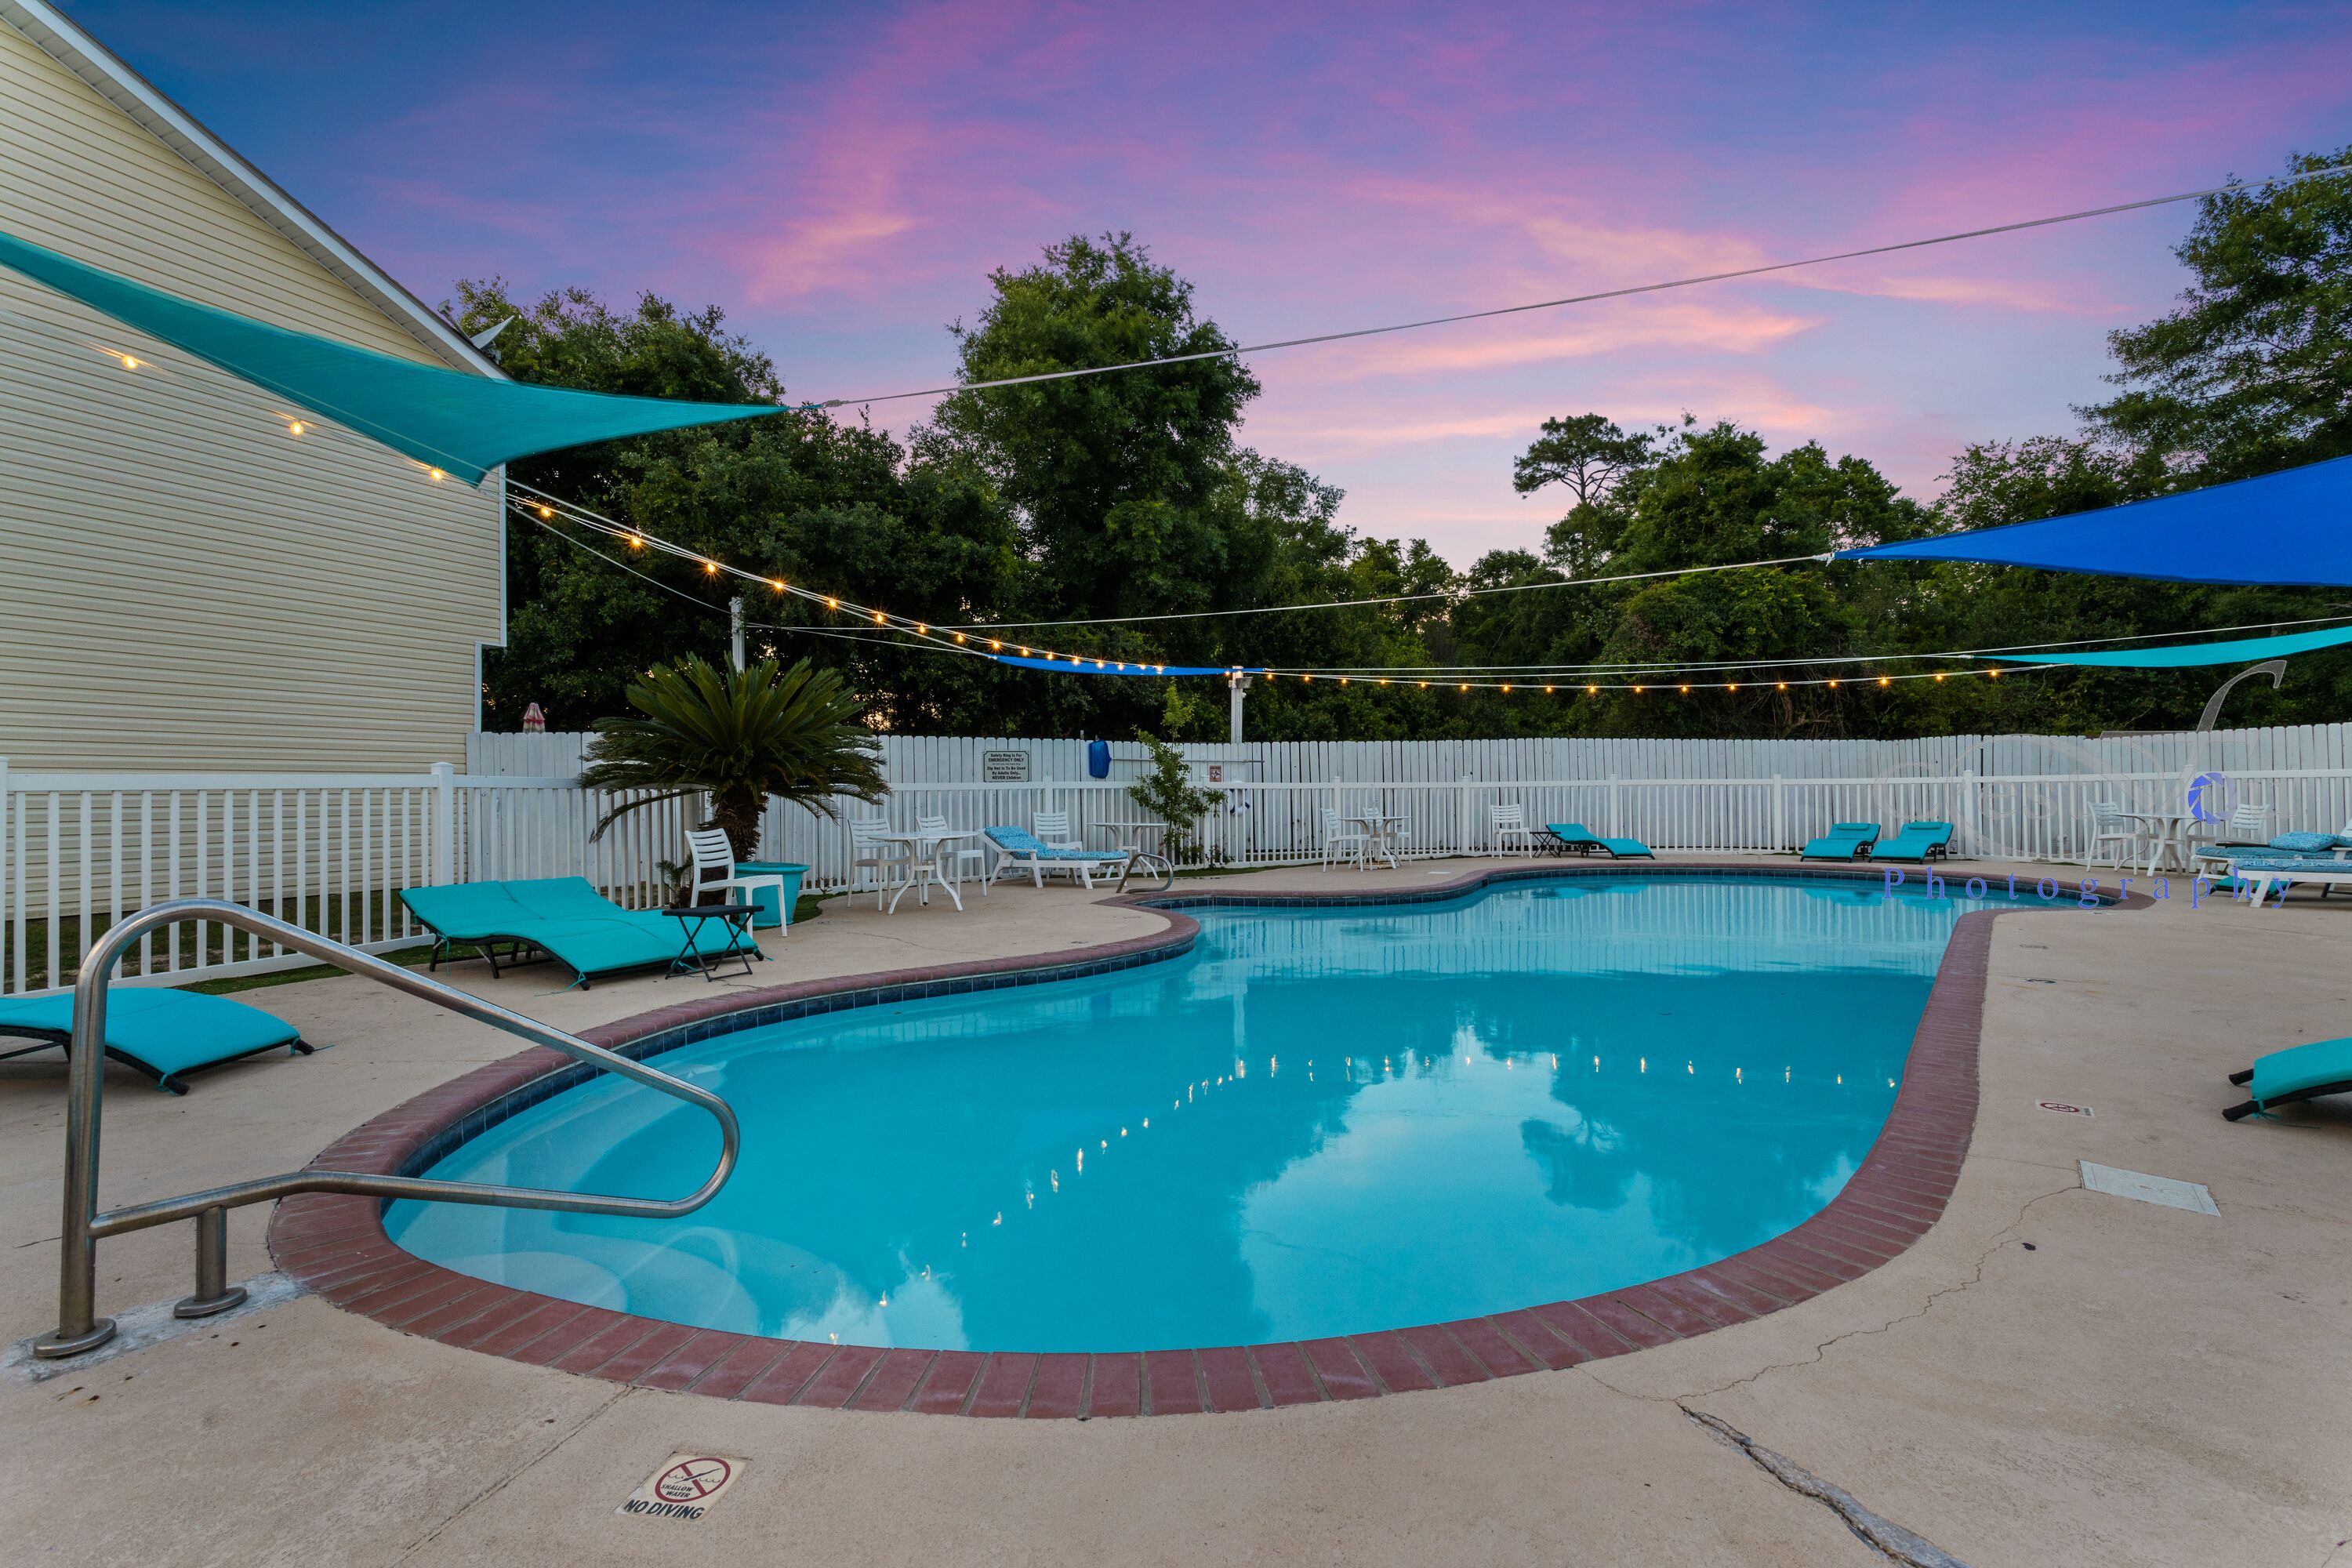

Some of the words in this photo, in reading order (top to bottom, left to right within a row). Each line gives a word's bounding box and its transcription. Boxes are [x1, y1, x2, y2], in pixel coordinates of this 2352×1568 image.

[661, 1483, 695, 1492] SHALLOW
[623, 1498, 649, 1514] NO
[646, 1501, 706, 1520] DIVING
